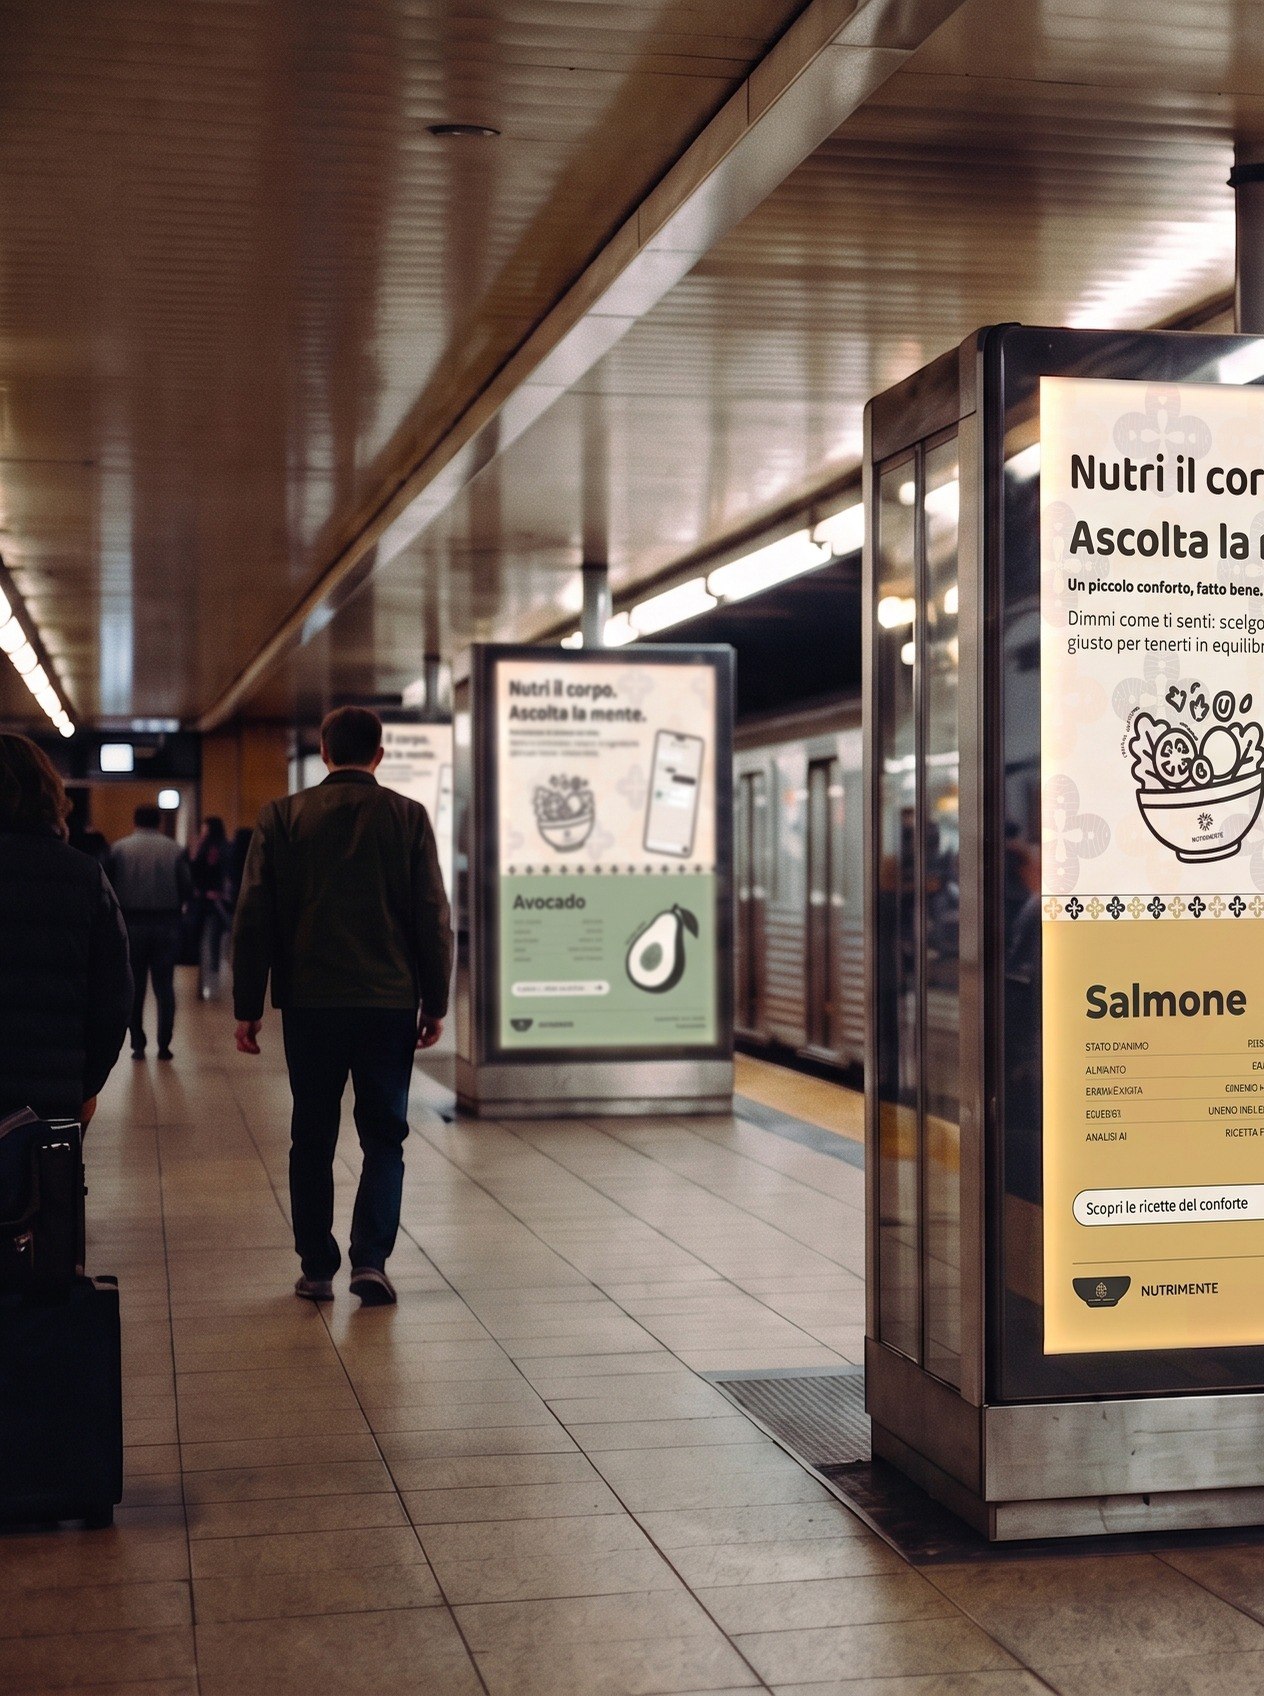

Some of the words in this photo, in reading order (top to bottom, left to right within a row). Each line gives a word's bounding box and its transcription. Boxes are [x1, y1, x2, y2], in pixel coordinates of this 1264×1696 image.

[1071, 453, 1165, 493] Nutri
[1176, 454, 1196, 494] il
[1069, 520, 1209, 560] Ascolta
[1219, 522, 1250, 561] la
[1067, 577, 1086, 592] Un
[1088, 577, 1135, 595] piccolo
[1136, 580, 1194, 597] conforto,
[1196, 581, 1227, 596] fatto
[1229, 582, 1264, 597] bene.
[1068, 609, 1115, 627] Dimmi
[1119, 615, 1160, 628] come
[1163, 612, 1172, 628] ti
[1176, 613, 1215, 629] senti:
[1067, 634, 1113, 655] giusto
[1117, 638, 1141, 655] per
[1144, 636, 1192, 652] tenerti
[1195, 636, 1208, 653] in
[512, 893, 587, 911] Avocado
[1085, 982, 1247, 1020] Salmone
[1085, 1042, 1112, 1052] STATO
[1112, 1041, 1150, 1052] D'ANIMO
[1085, 1131, 1118, 1142] ANALISI
[1225, 1127, 1259, 1138] RICETTA
[1086, 1200, 1123, 1218] Scopri
[1125, 1200, 1137, 1214] le
[1139, 1199, 1177, 1213] ricette
[1178, 1198, 1197, 1212] del
[1199, 1196, 1249, 1211] conforte
[1141, 1282, 1219, 1297] NUTRIMENTE
